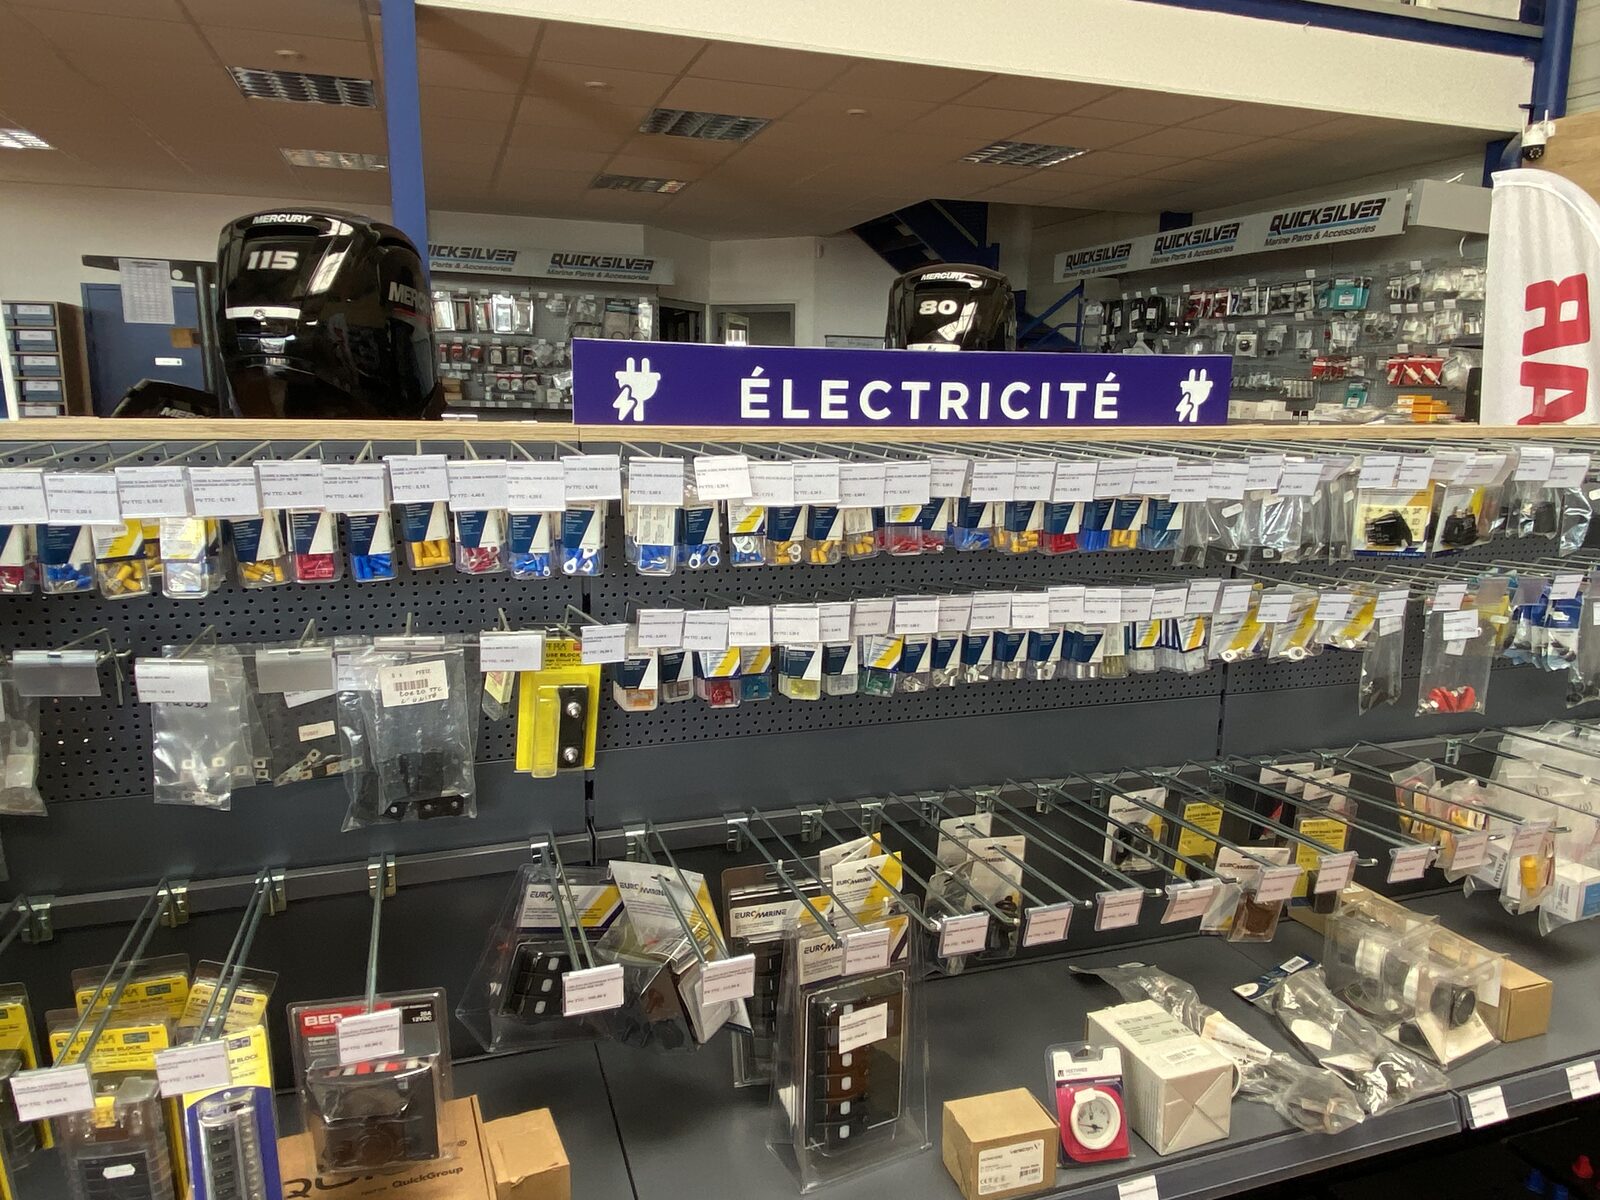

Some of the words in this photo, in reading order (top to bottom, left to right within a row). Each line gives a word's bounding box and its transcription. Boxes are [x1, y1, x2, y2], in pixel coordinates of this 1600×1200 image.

[252, 213, 312, 224] MERCURY
[1269, 198, 1387, 236] QUICKSILVER
[1154, 222, 1240, 254] QUICKSILVER
[1264, 236, 1290, 247] Marine
[1292, 232, 1312, 244] Parts
[1314, 231, 1321, 240] &
[1322, 224, 1377, 238] Accessories
[246, 250, 299, 272] 115
[428, 244, 517, 263] ICKSILVER
[550, 252, 655, 272] QUICKSILVER
[1065, 242, 1132, 270] QUICKSILVER
[1150, 256, 1170, 265] Marine
[1171, 254, 1187, 262] Parts
[1194, 245, 1234, 258] Accessories
[431, 262, 454, 270] Parts
[462, 264, 512, 272] Accessories
[547, 268, 573, 276] Marine
[575, 270, 594, 278] Parts
[604, 272, 650, 281] Accessories
[920, 271, 967, 282] MERCURY
[919, 299, 958, 316] 80
[740, 366, 1120, 421] ÉLECTRICITÉ
[734, 908, 787, 920] EUROMARINE
[392, 1166, 464, 1188] QuickGroup
